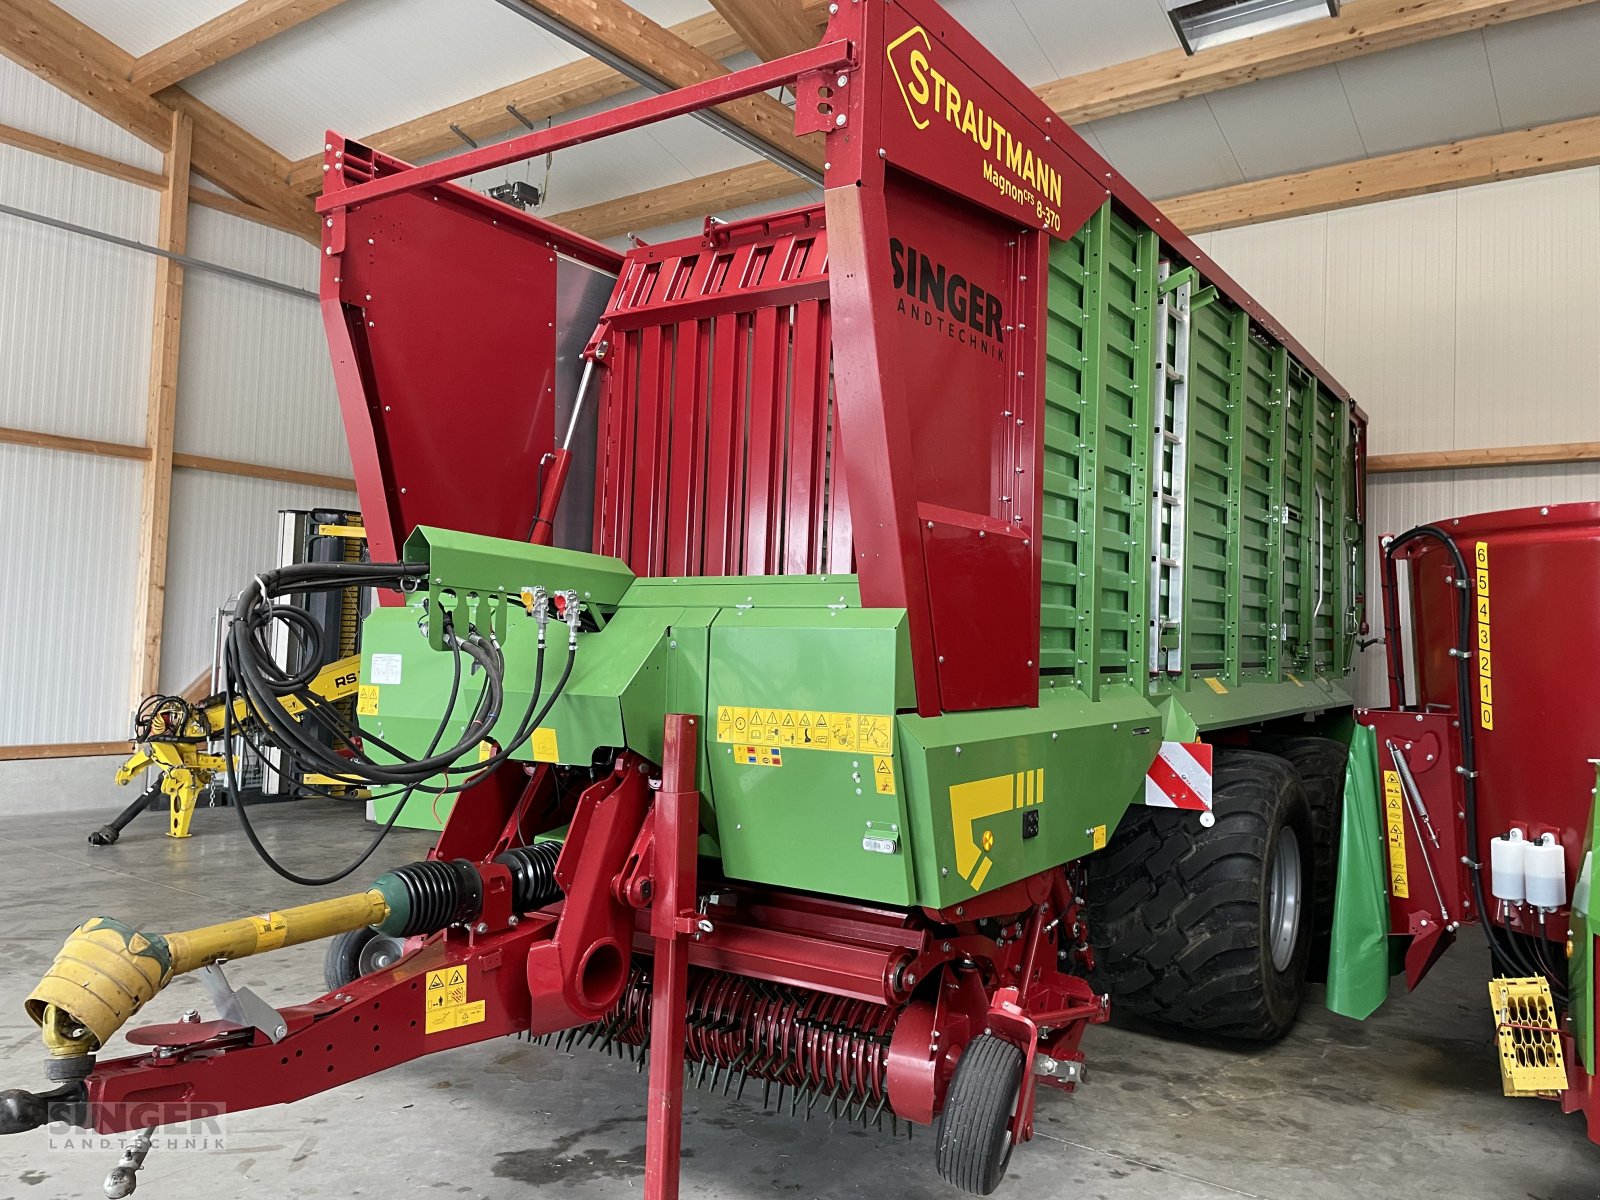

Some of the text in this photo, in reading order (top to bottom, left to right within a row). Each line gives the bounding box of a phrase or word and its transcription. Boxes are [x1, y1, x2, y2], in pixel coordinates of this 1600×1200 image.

[908, 48, 1063, 208] STRAUTMANN
[1036, 200, 1061, 232] 8-370
[889, 237, 1004, 344] SINGER
[897, 298, 1005, 362] ANDTECHNIK
[1477, 548, 1486, 562] 6
[1479, 575, 1487, 589] 5
[1479, 603, 1488, 617] 4
[1480, 629, 1488, 644] 3
[1481, 656, 1489, 671] 2
[334, 672, 357, 689] RS
[1483, 684, 1489, 698] 1
[1483, 709, 1491, 724] 0
